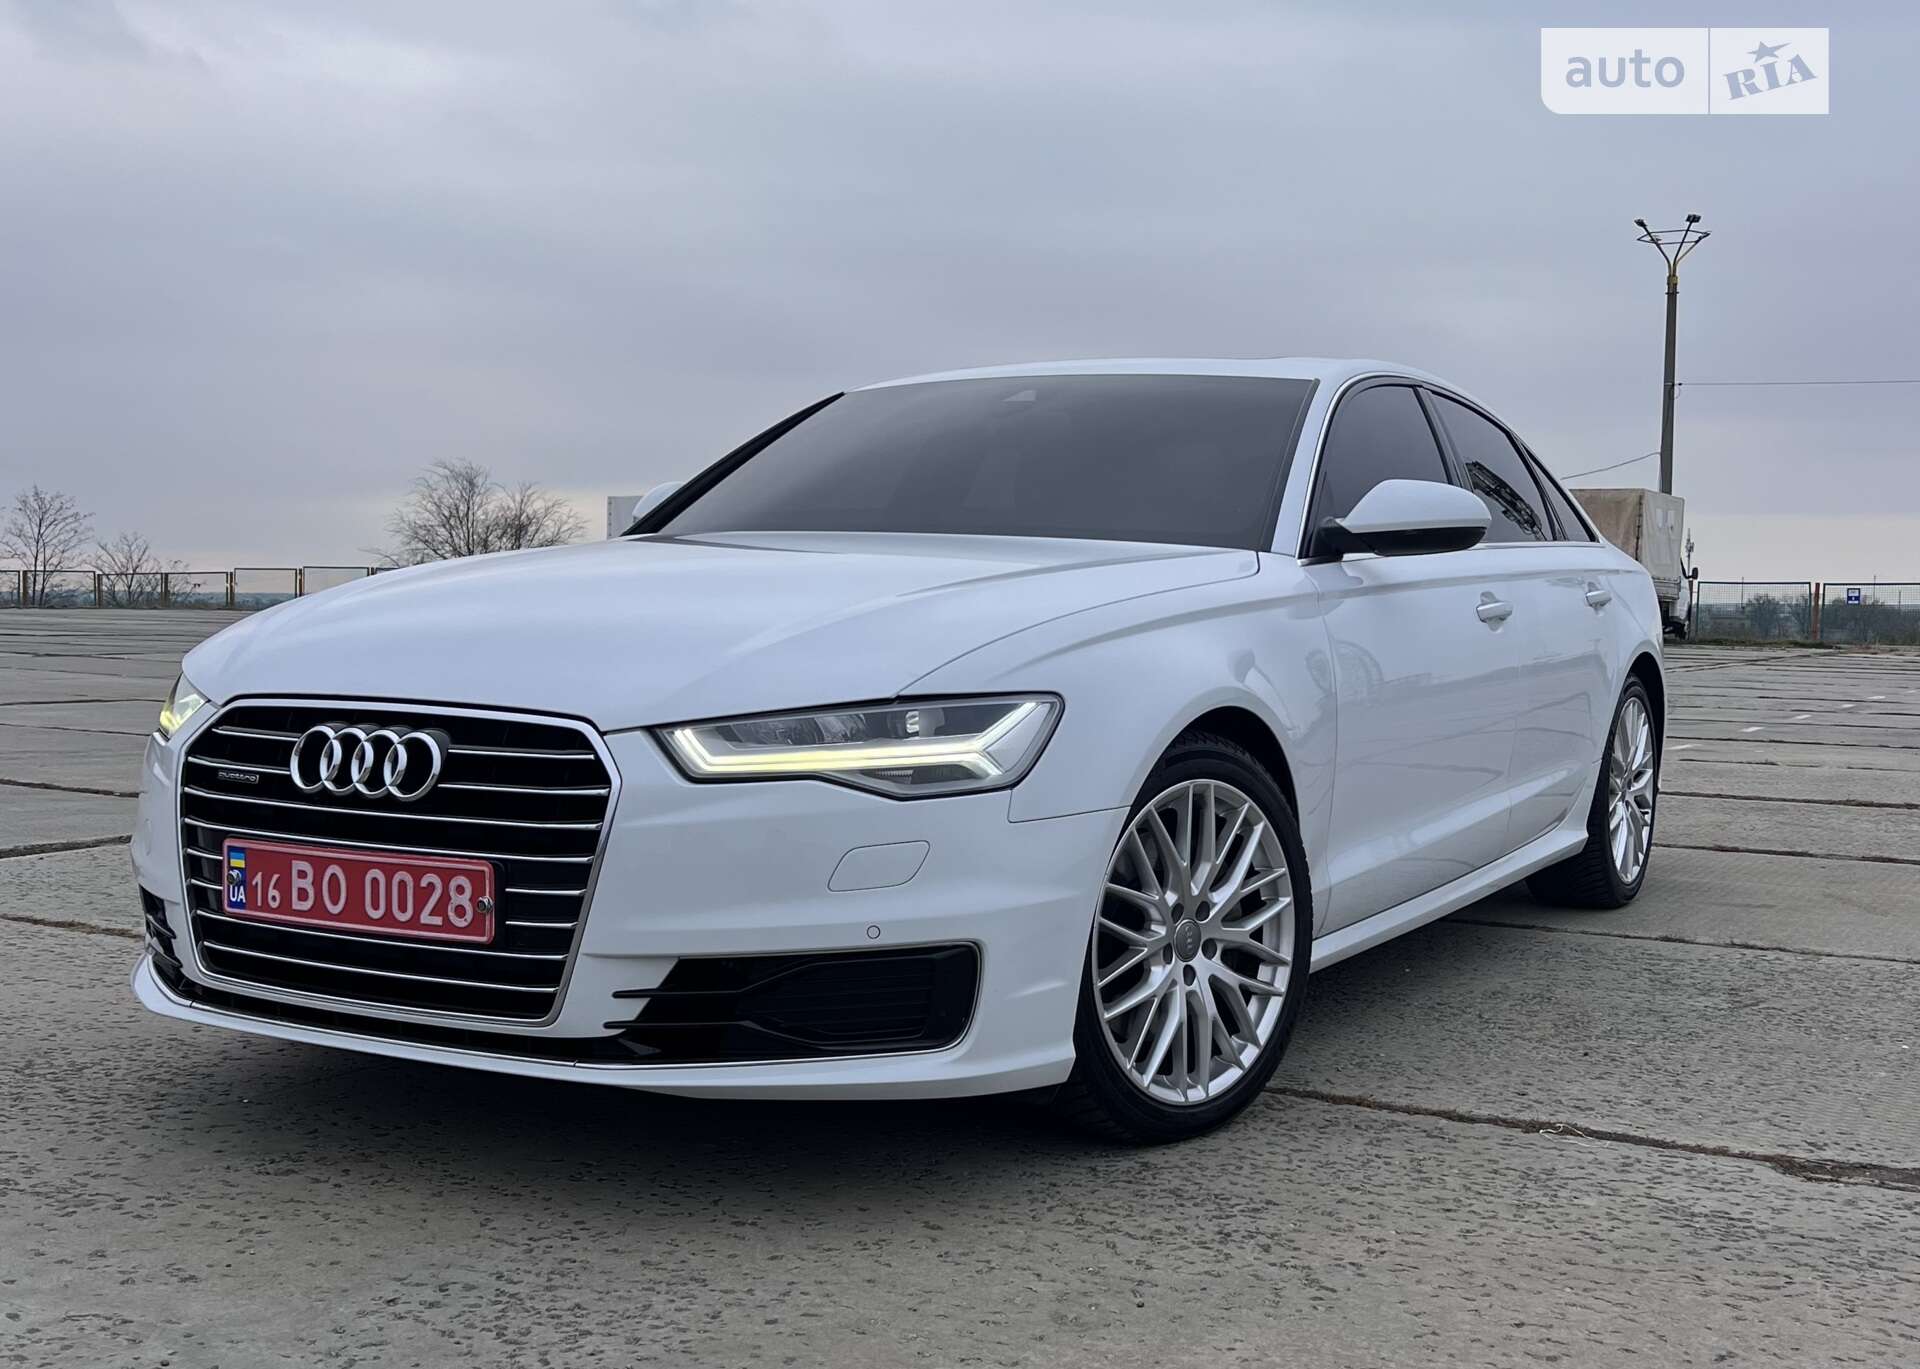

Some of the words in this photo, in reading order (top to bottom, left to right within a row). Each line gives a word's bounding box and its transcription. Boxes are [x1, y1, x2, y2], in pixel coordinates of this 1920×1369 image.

[229, 885, 246, 903] UA
[251, 871, 281, 909] 16
[291, 859, 347, 915] BO
[364, 868, 474, 928] 0028
